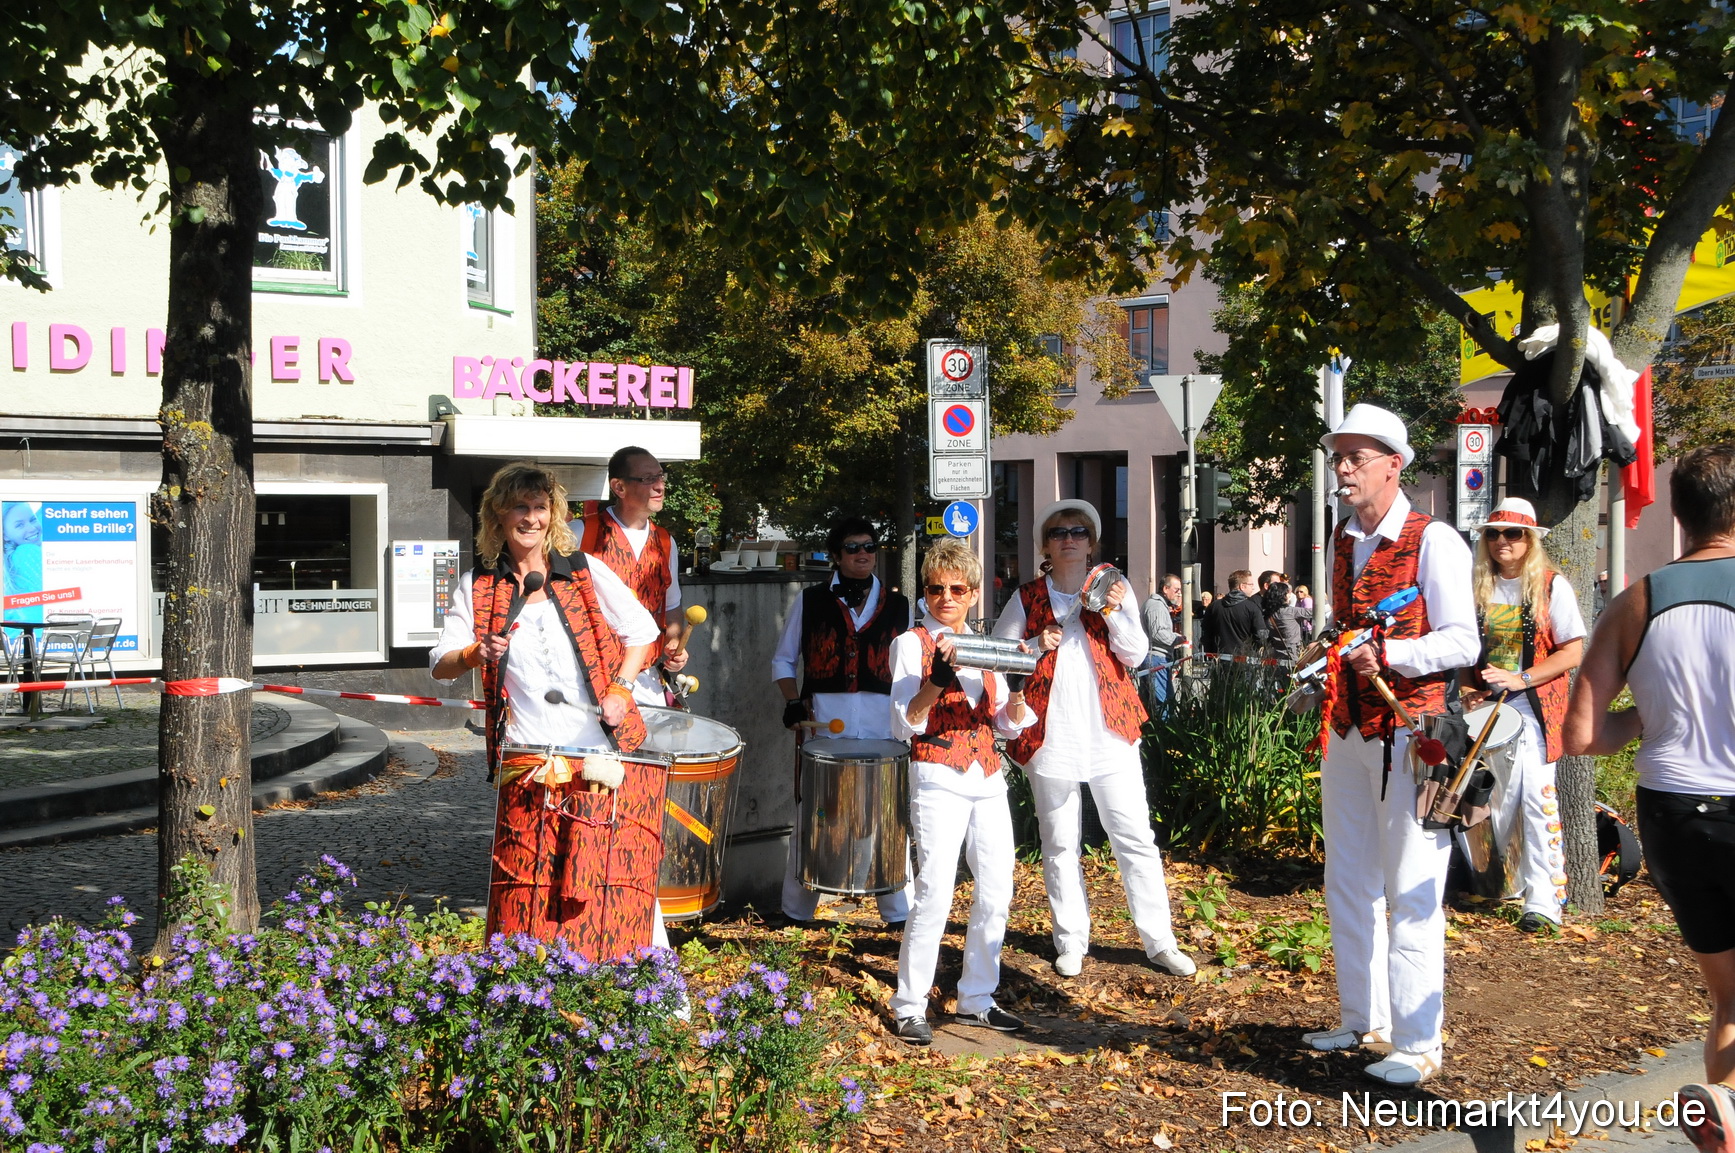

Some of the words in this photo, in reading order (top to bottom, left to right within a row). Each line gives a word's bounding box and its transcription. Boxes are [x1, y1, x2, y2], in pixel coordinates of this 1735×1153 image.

[948, 358, 967, 373] 30
[1698, 369, 1714, 377] Obere
[453, 355, 692, 409] BÄCKEREI
[946, 384, 970, 392] ZONE
[947, 440, 972, 448] ZONE
[1469, 437, 1480, 447] 30
[45, 508, 88, 519] Scharf
[90, 508, 129, 519] sehen
[57, 523, 90, 534] ohne
[93, 523, 134, 534] Brille?
[76, 558, 133, 566] Laserbehandlung
[11, 595, 40, 606] Fragen
[42, 592, 56, 602] Sie
[57, 590, 75, 600] uns!
[88, 607, 123, 615] Augenarzt
